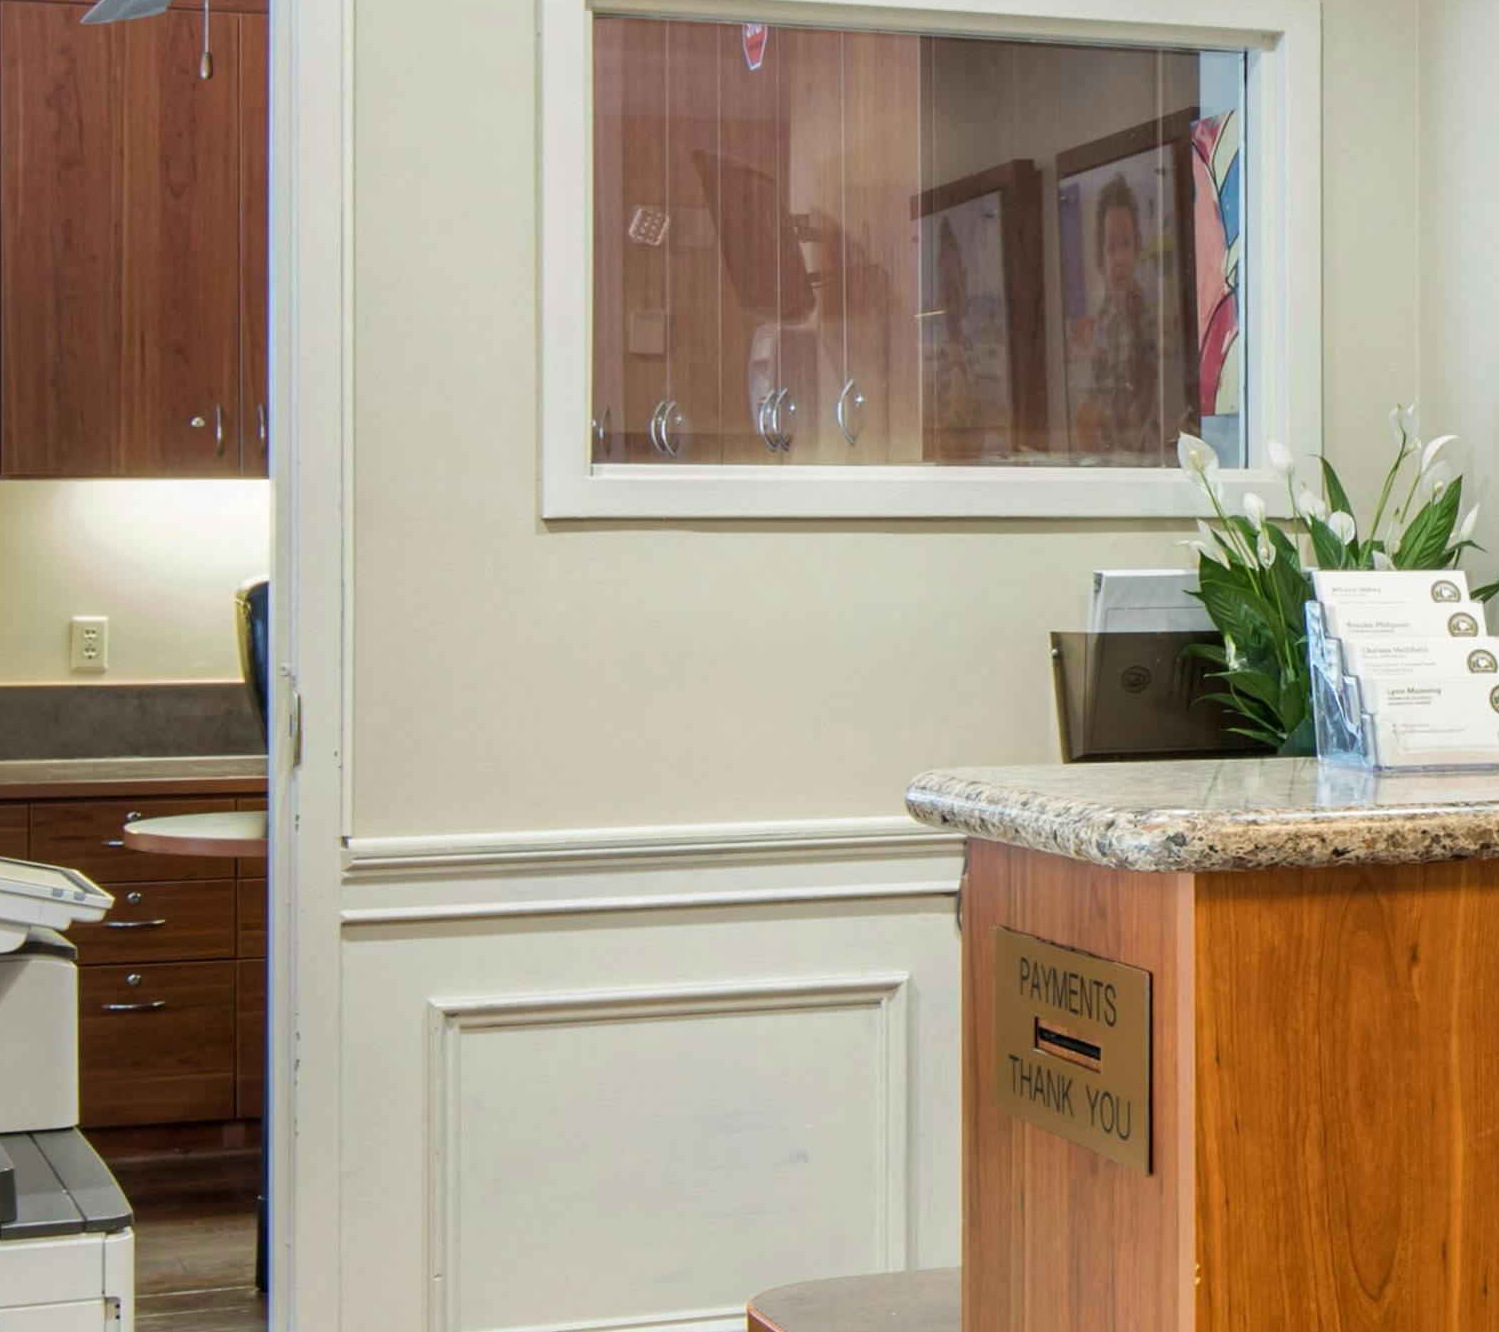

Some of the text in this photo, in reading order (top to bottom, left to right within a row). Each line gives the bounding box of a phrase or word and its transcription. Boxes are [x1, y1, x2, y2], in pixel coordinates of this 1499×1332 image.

[1407, 687, 1442, 695] Manning
[1019, 956, 1117, 1028] PAYMENTS
[1008, 1054, 1131, 1141] THANK YOU
